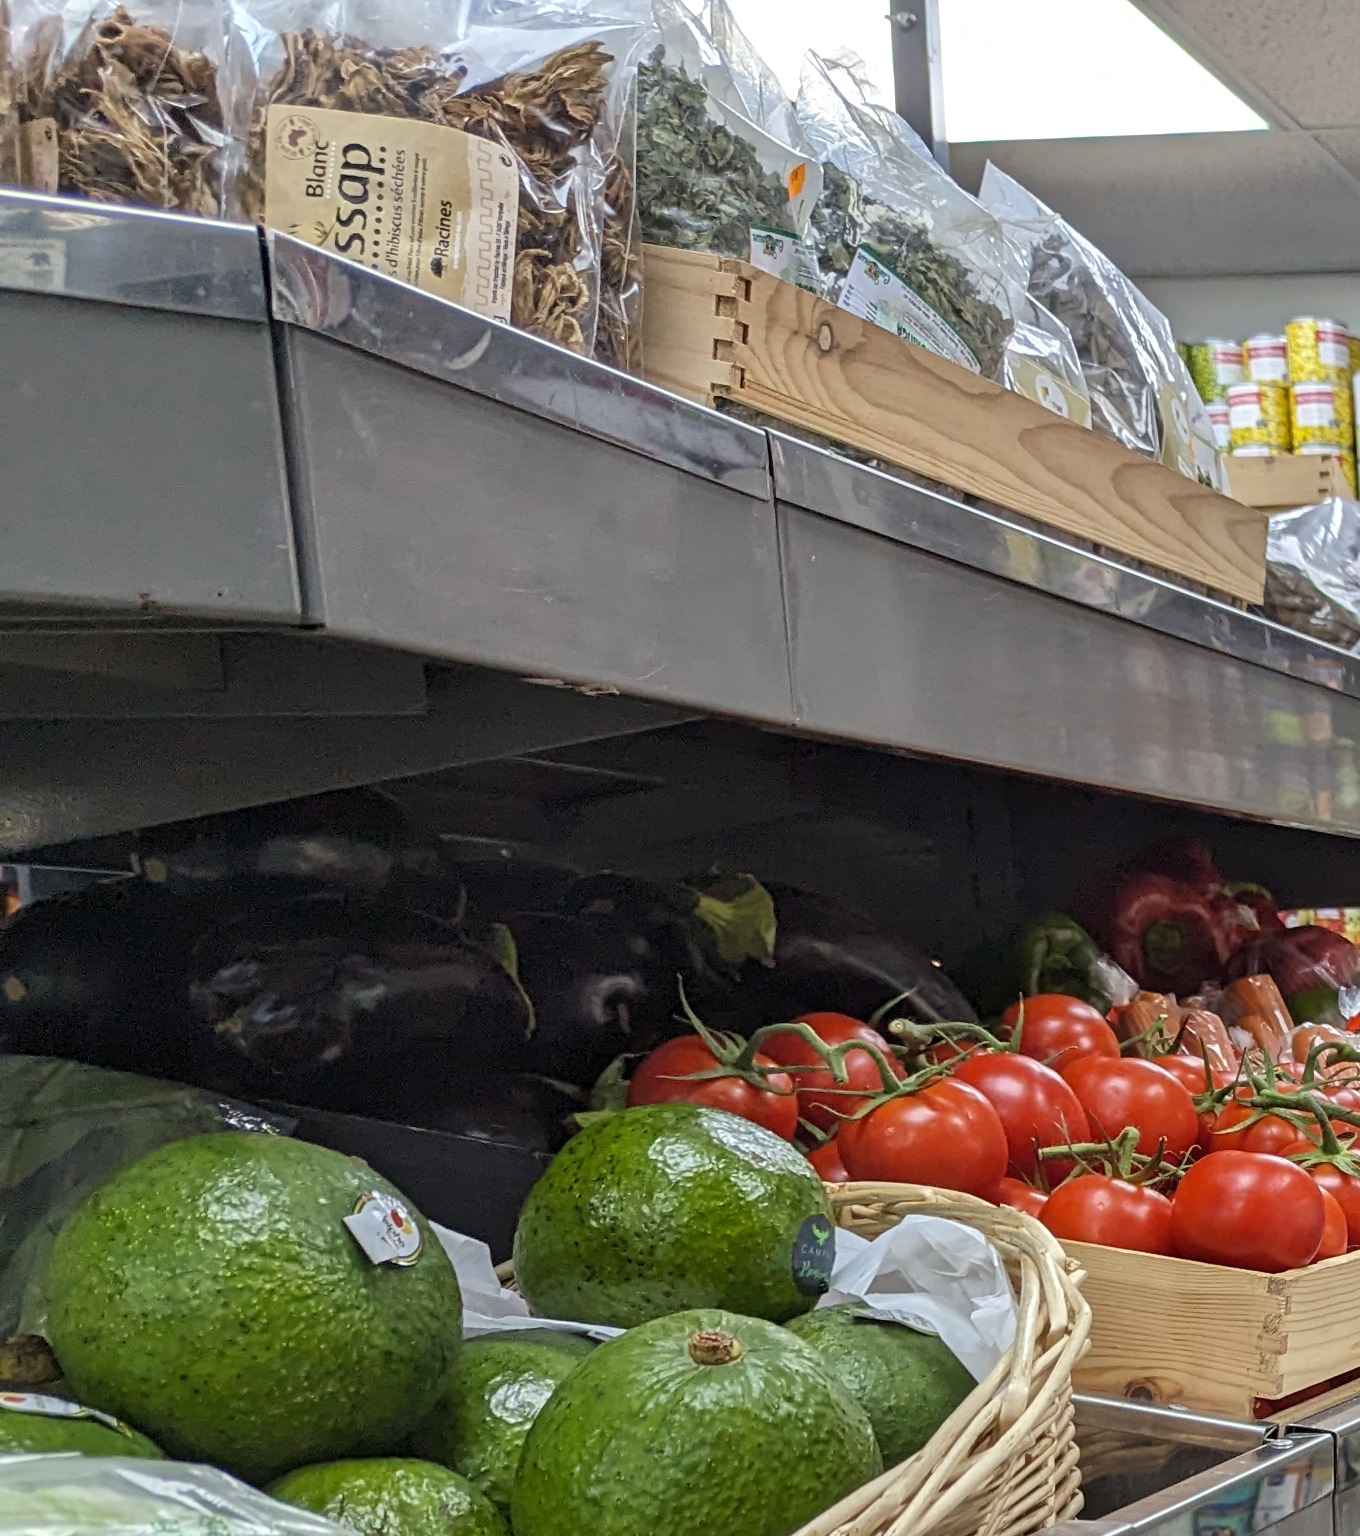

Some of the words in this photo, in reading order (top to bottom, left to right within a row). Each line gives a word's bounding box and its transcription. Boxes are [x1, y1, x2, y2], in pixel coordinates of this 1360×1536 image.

[304, 139, 330, 198] Blanc
[389, 149, 408, 202] séchées
[334, 142, 387, 266] ssap
[433, 200, 453, 258] Racines
[386, 205, 404, 268] d'hibiscus
